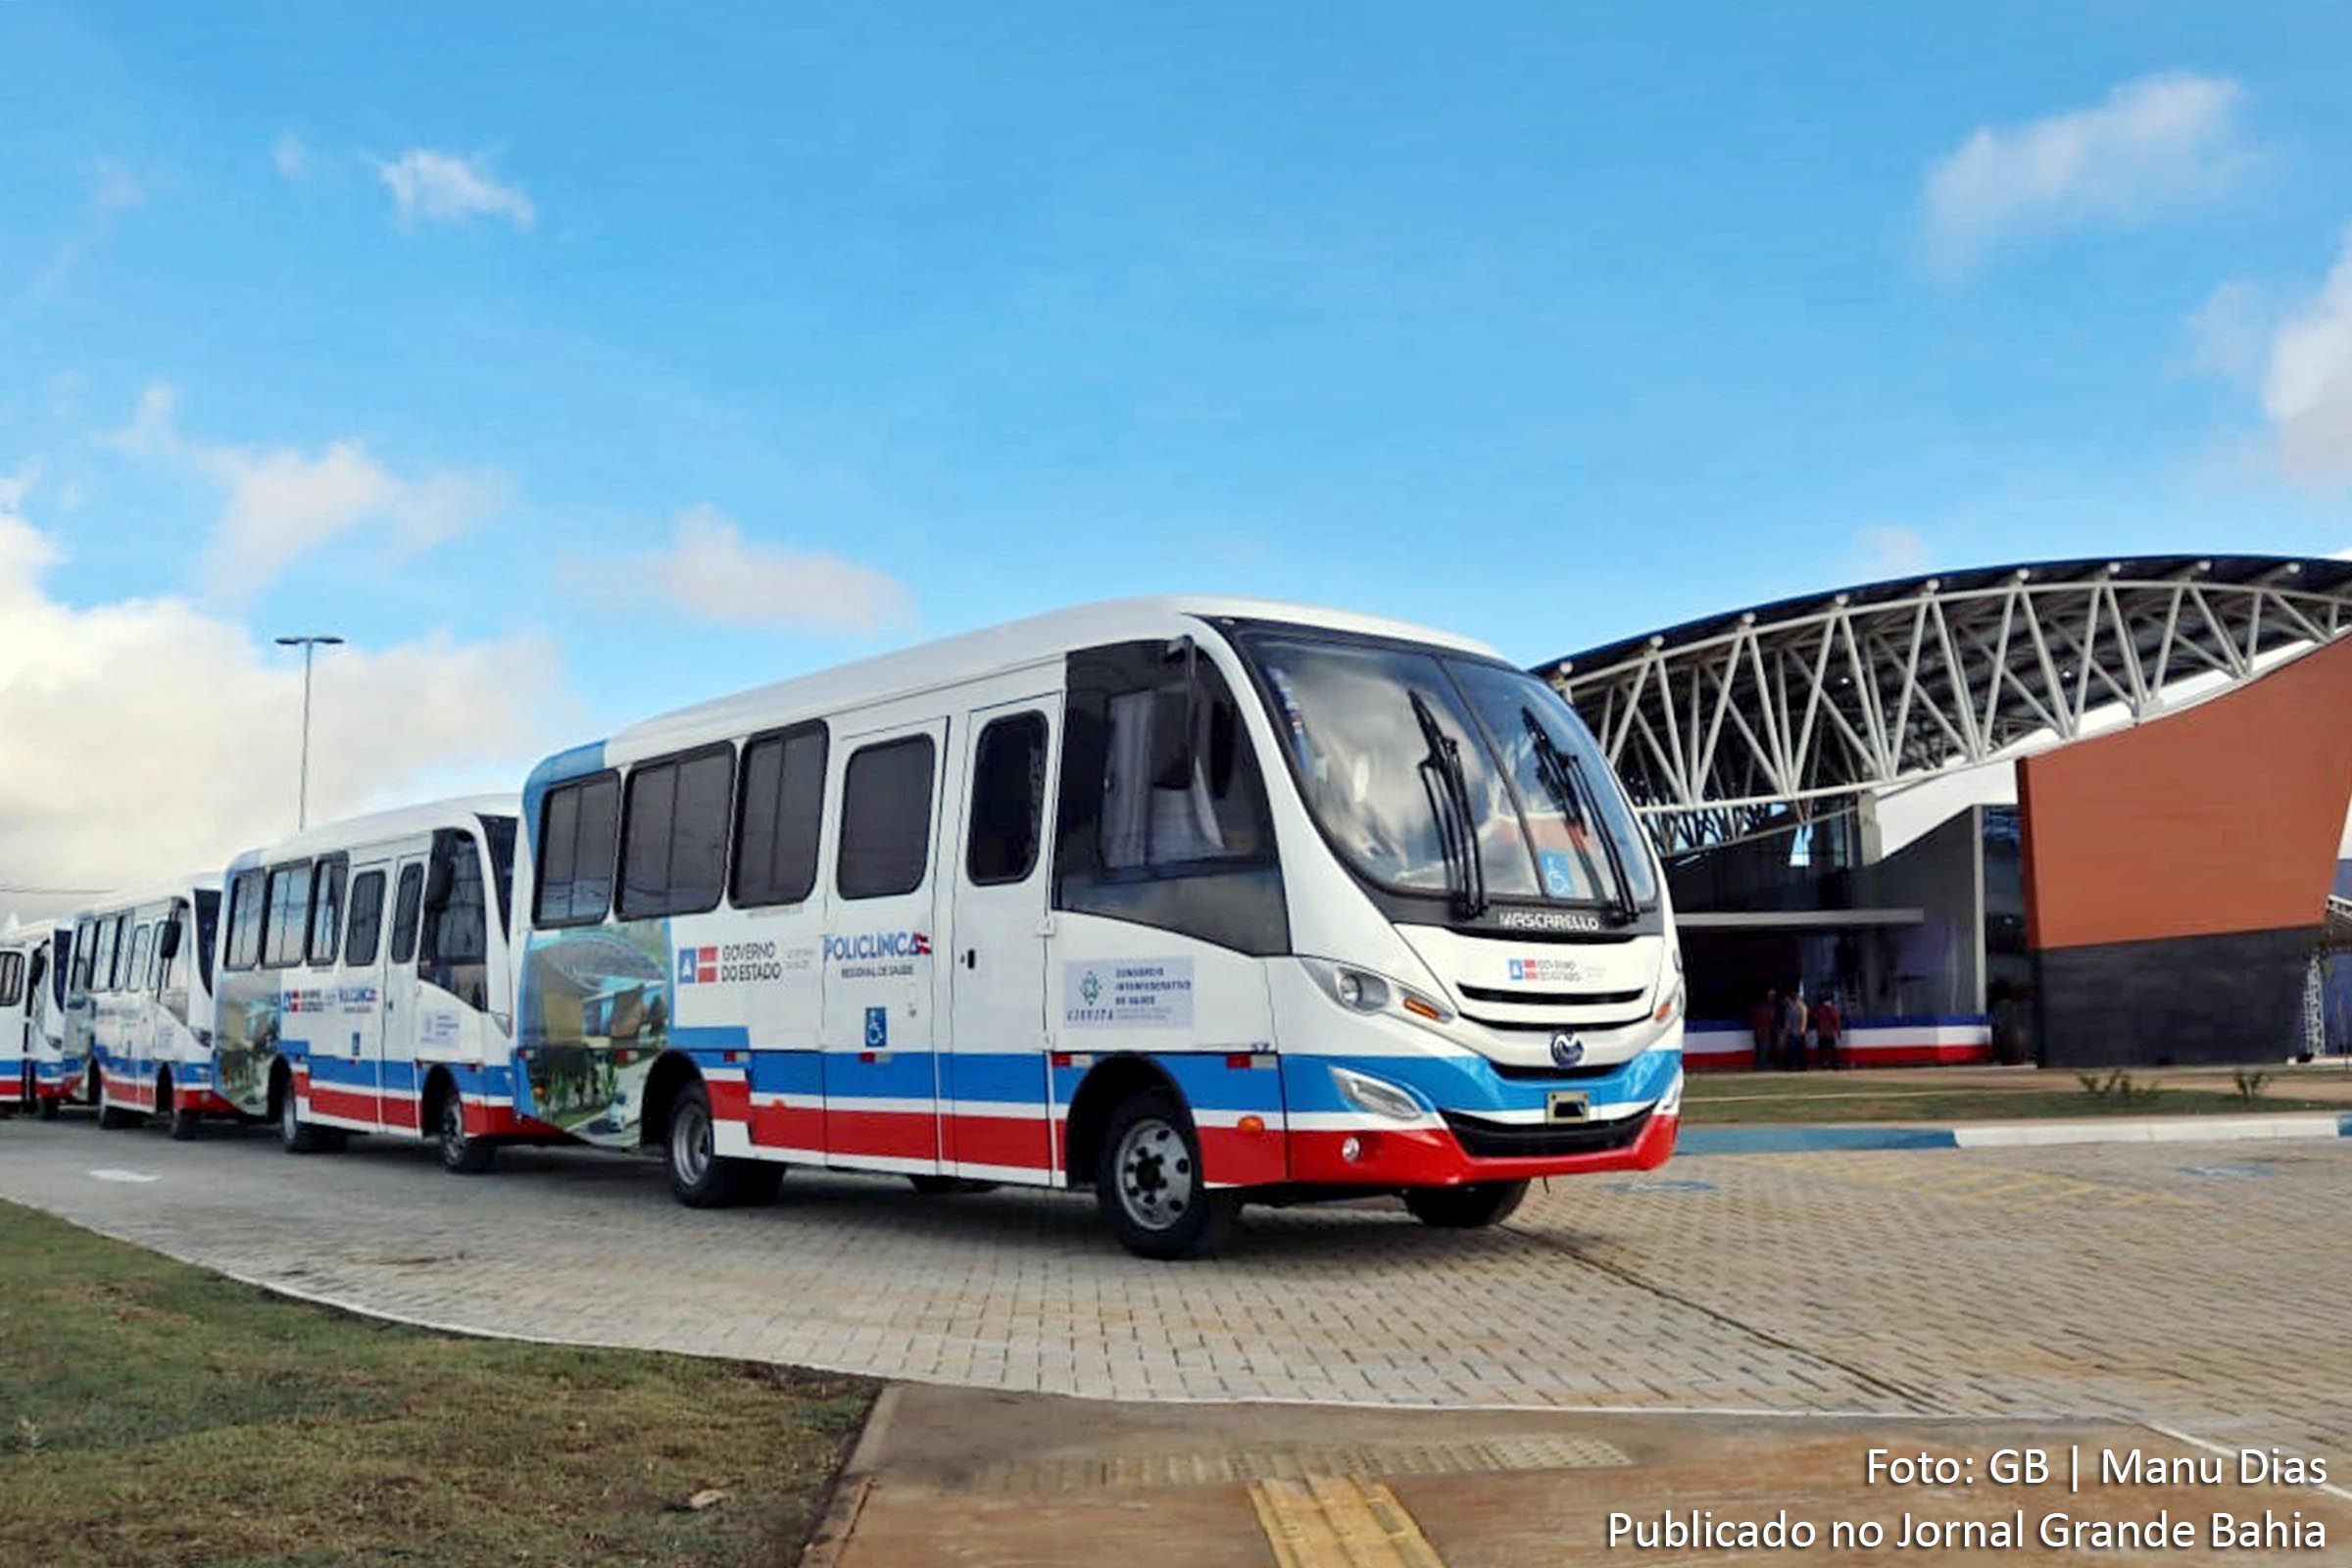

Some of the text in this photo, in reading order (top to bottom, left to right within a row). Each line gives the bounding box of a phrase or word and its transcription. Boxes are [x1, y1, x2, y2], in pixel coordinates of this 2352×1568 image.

[1498, 911, 1599, 930] MASCARELLO
[721, 941, 775, 961] GOVERNO
[720, 961, 782, 983] DO ESTADO
